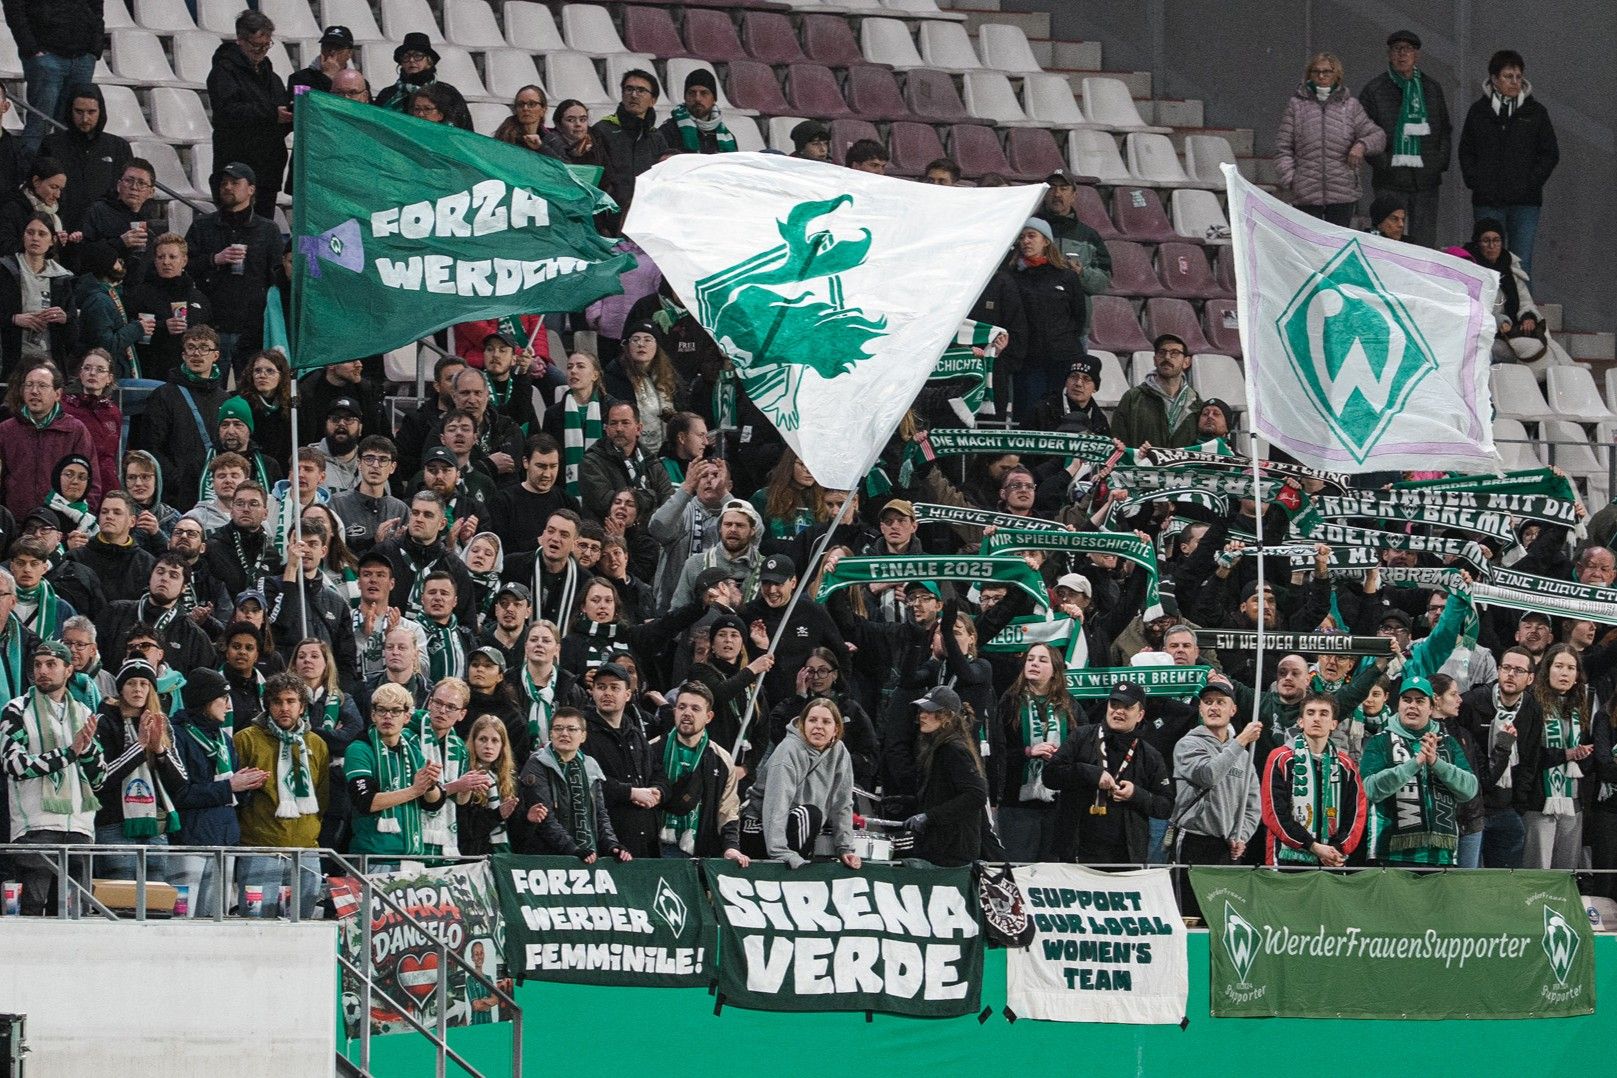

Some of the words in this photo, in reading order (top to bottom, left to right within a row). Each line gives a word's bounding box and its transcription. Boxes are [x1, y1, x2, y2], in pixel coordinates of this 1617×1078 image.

[370, 179, 550, 240] FORZA
[930, 434, 953, 448] DIE
[956, 436, 1002, 448] MACHT
[1007, 437, 1036, 448] VON
[1038, 437, 1065, 449] DER
[1068, 439, 1115, 456] WESER
[1482, 475, 1544, 486] BREMEN
[1315, 495, 1396, 517] ERDER
[1487, 494, 1536, 512] MIT
[989, 532, 1013, 547] WIR
[1016, 532, 1069, 546] SPIELEN
[1071, 537, 1152, 558] GESCHICHTE
[1289, 520, 1381, 547] ERDER
[943, 561, 993, 577] 2025
[1216, 634, 1234, 649] SV
[1299, 635, 1353, 650] BREMEN
[1066, 674, 1084, 687] SV
[1088, 671, 1146, 686] WERDER
[1151, 671, 1204, 684] BREMEN
[1293, 753, 1309, 797] 2022
[511, 869, 618, 896] FORZA
[1027, 887, 1142, 912] SUPPORT
[520, 904, 655, 934] WERDER
[1034, 913, 1086, 934] OUR
[1088, 916, 1173, 936] LOCAL
[1042, 939, 1153, 964] WOMEN'S
[1263, 924, 1531, 969] WerderFrauenSupporter
[743, 934, 970, 1001] VERDE
[1063, 967, 1132, 992] TEAM
[1224, 983, 1266, 1005] Supporter
